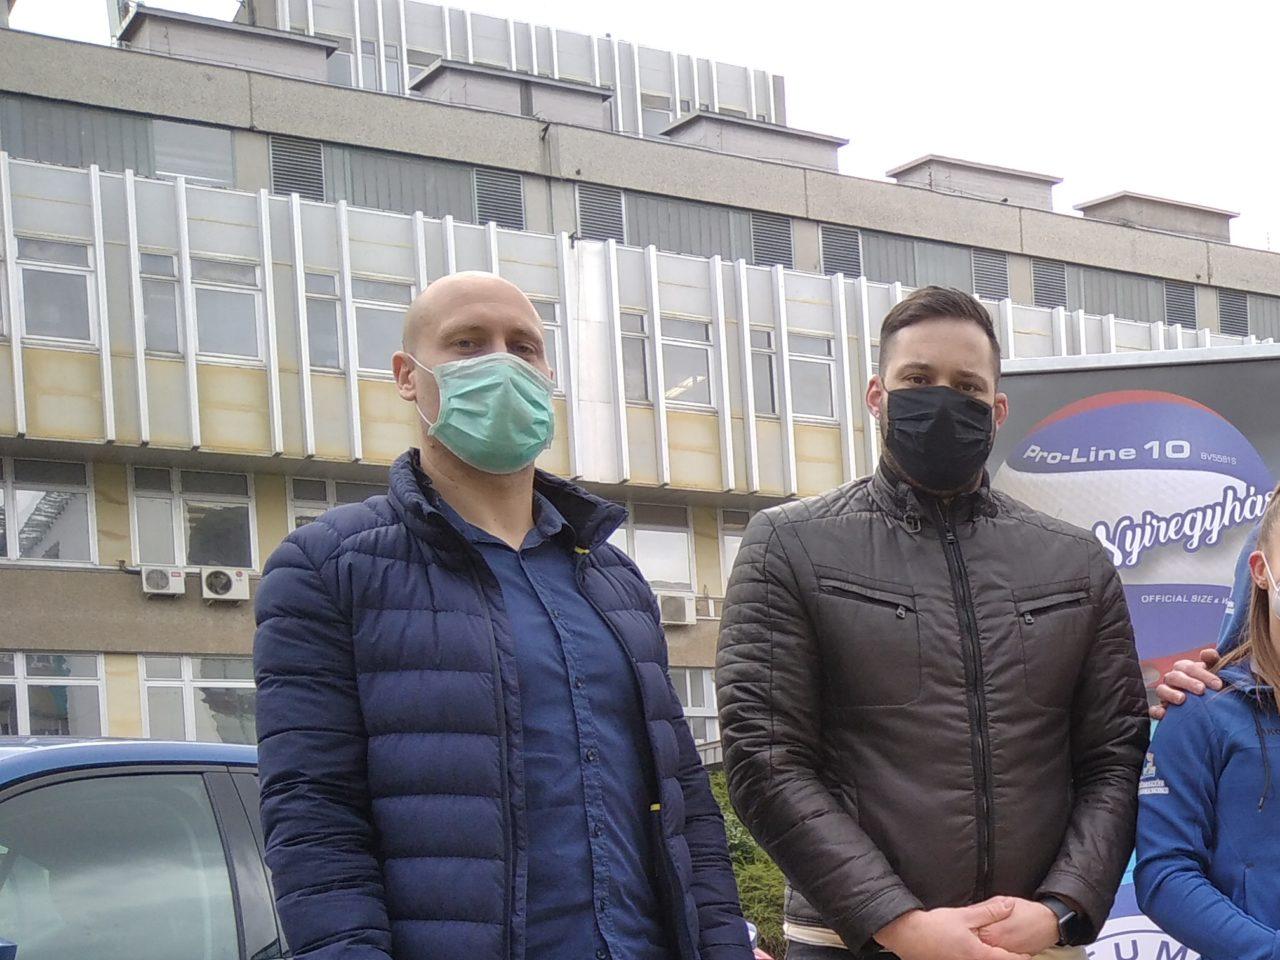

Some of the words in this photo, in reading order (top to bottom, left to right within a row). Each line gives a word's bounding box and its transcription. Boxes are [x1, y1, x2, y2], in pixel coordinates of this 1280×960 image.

[1023, 444, 1136, 464] Pro-Line
[1143, 440, 1191, 459] 10
[1141, 594, 1188, 604] OFFICIAL
[1191, 594, 1214, 604] SIZE
